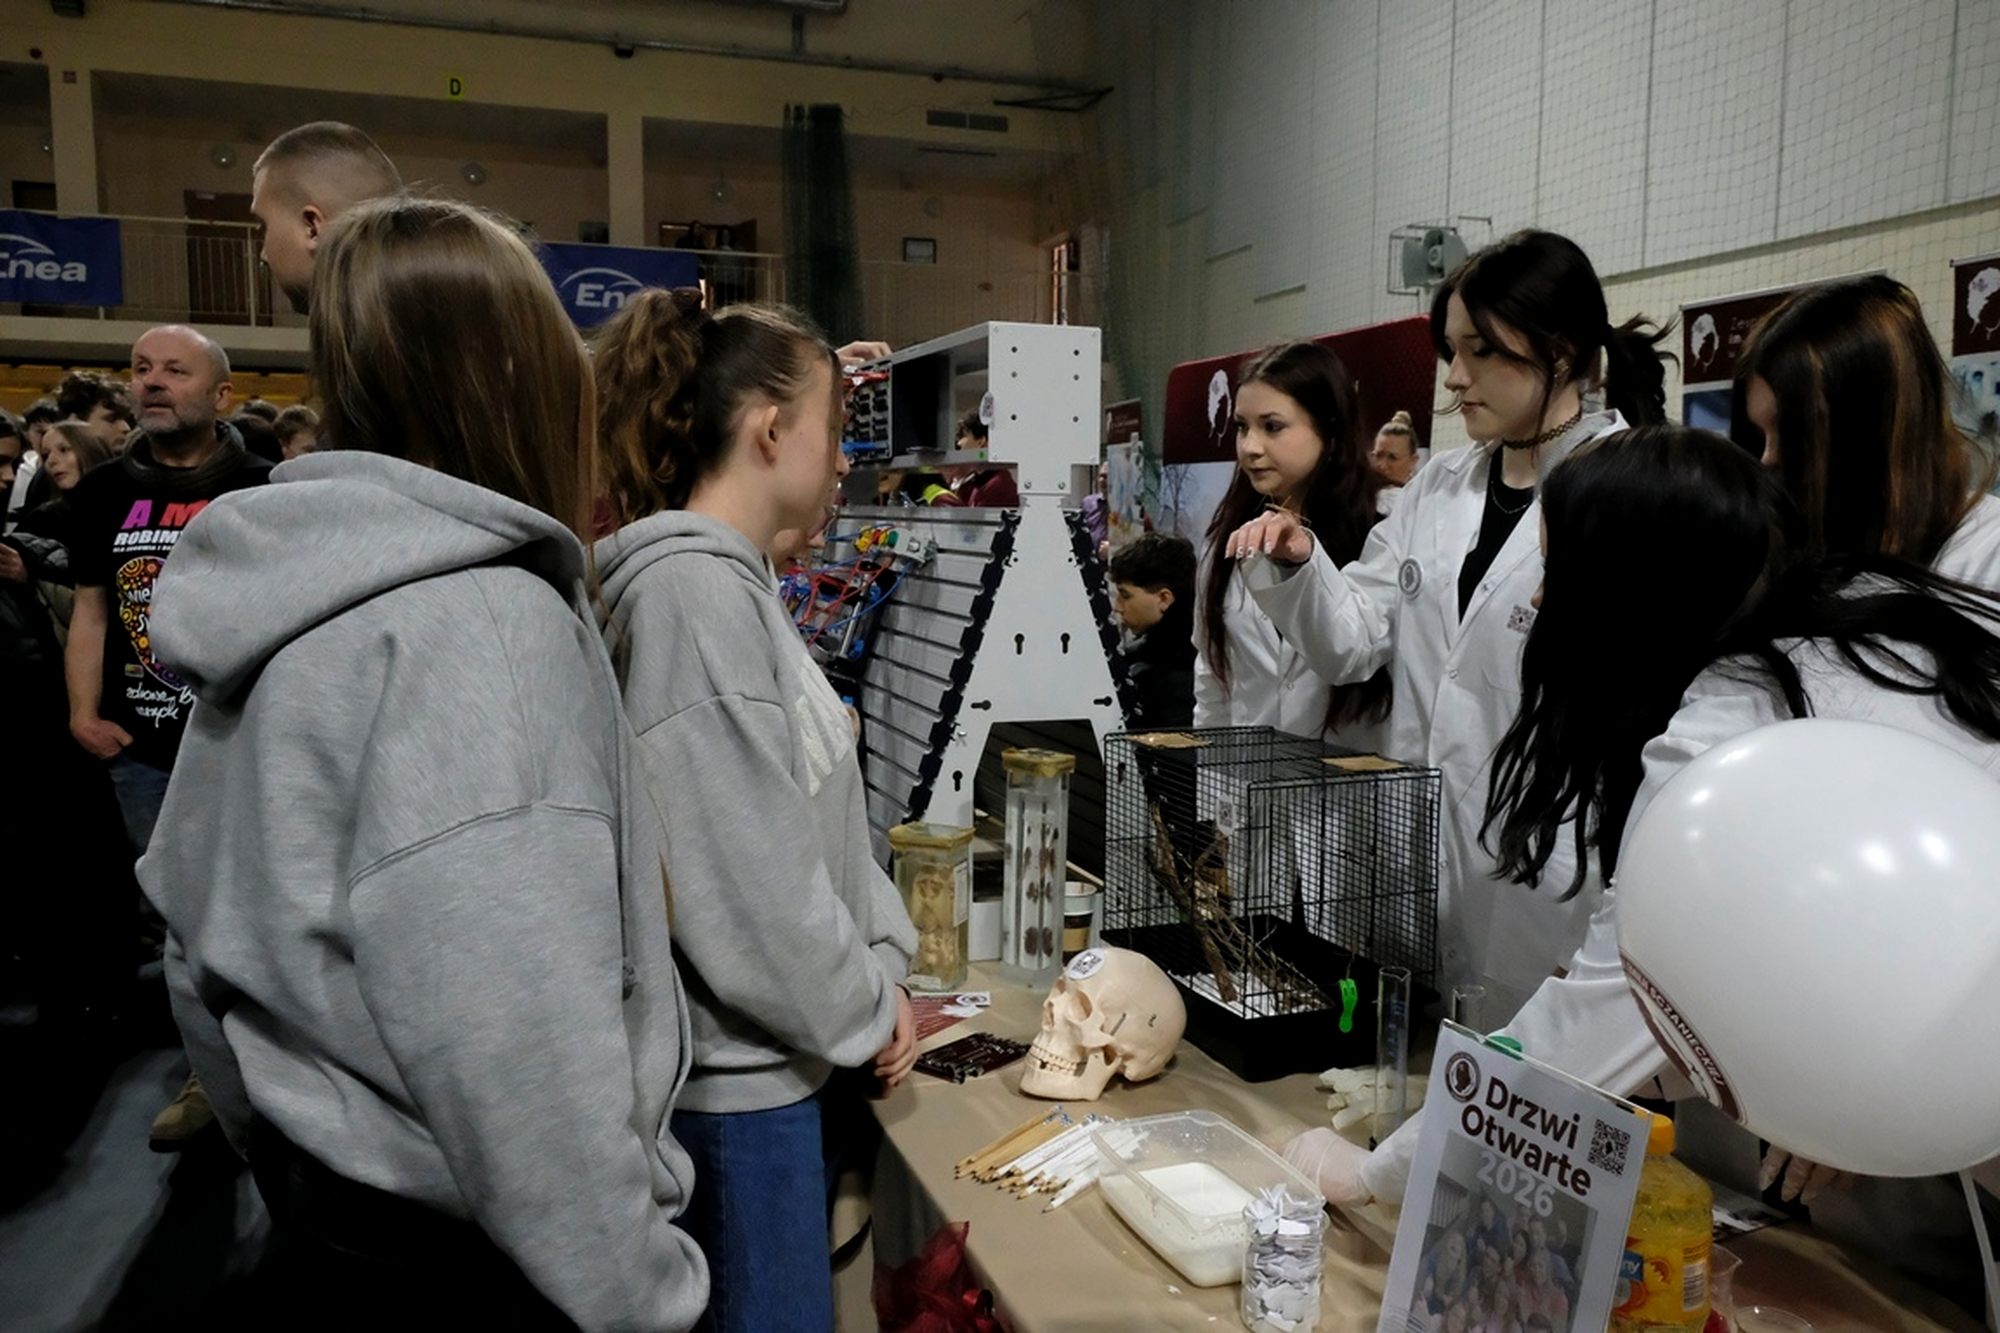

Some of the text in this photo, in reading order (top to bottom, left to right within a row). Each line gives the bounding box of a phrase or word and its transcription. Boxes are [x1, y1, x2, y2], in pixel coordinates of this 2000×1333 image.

[449, 77, 463, 97] D
[575, 282, 636, 309] En
[121, 499, 153, 530] A
[113, 529, 184, 547] ROBIM
[1485, 1075, 1581, 1150] Drzwi
[1461, 1103, 1592, 1197] Otwarte
[1475, 1152, 1556, 1218] 2026
